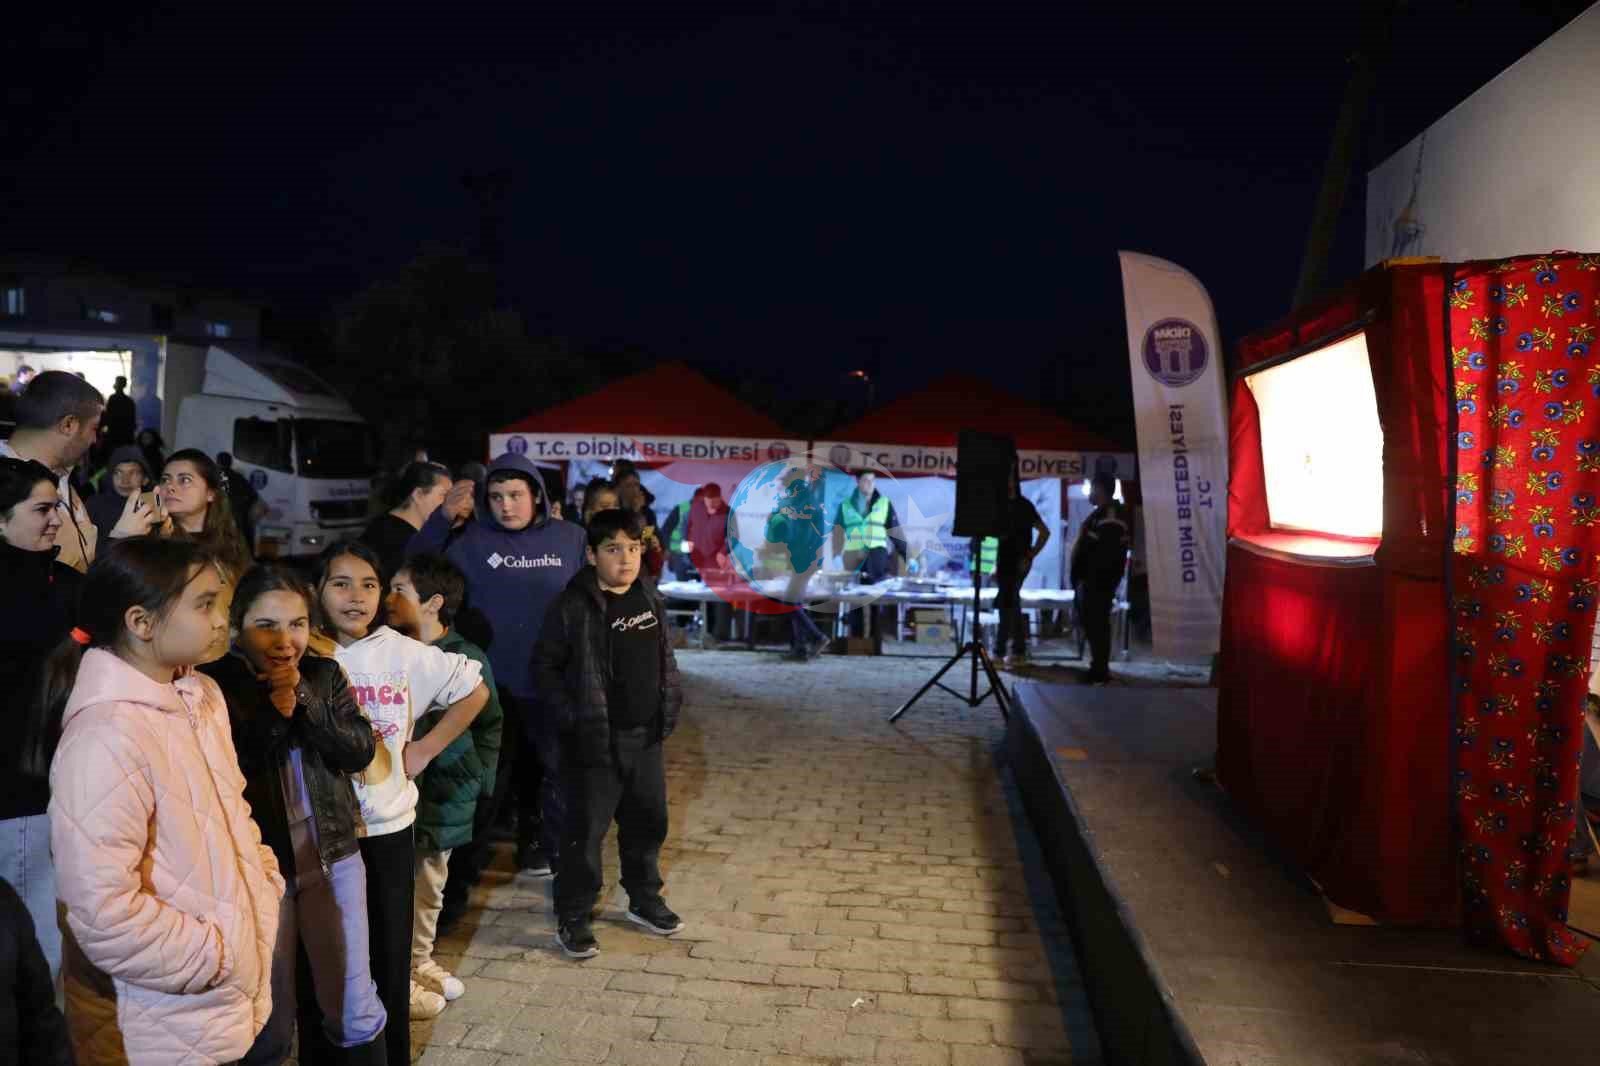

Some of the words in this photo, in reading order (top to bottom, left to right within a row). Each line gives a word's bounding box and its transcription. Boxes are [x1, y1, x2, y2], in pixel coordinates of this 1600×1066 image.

[535, 441, 571, 456] T.C.
[576, 436, 636, 456] DİDİM
[643, 440, 759, 461] BELEDİYESİ
[1022, 455, 1087, 475] DİYESİ
[503, 554, 562, 568] Columbia
